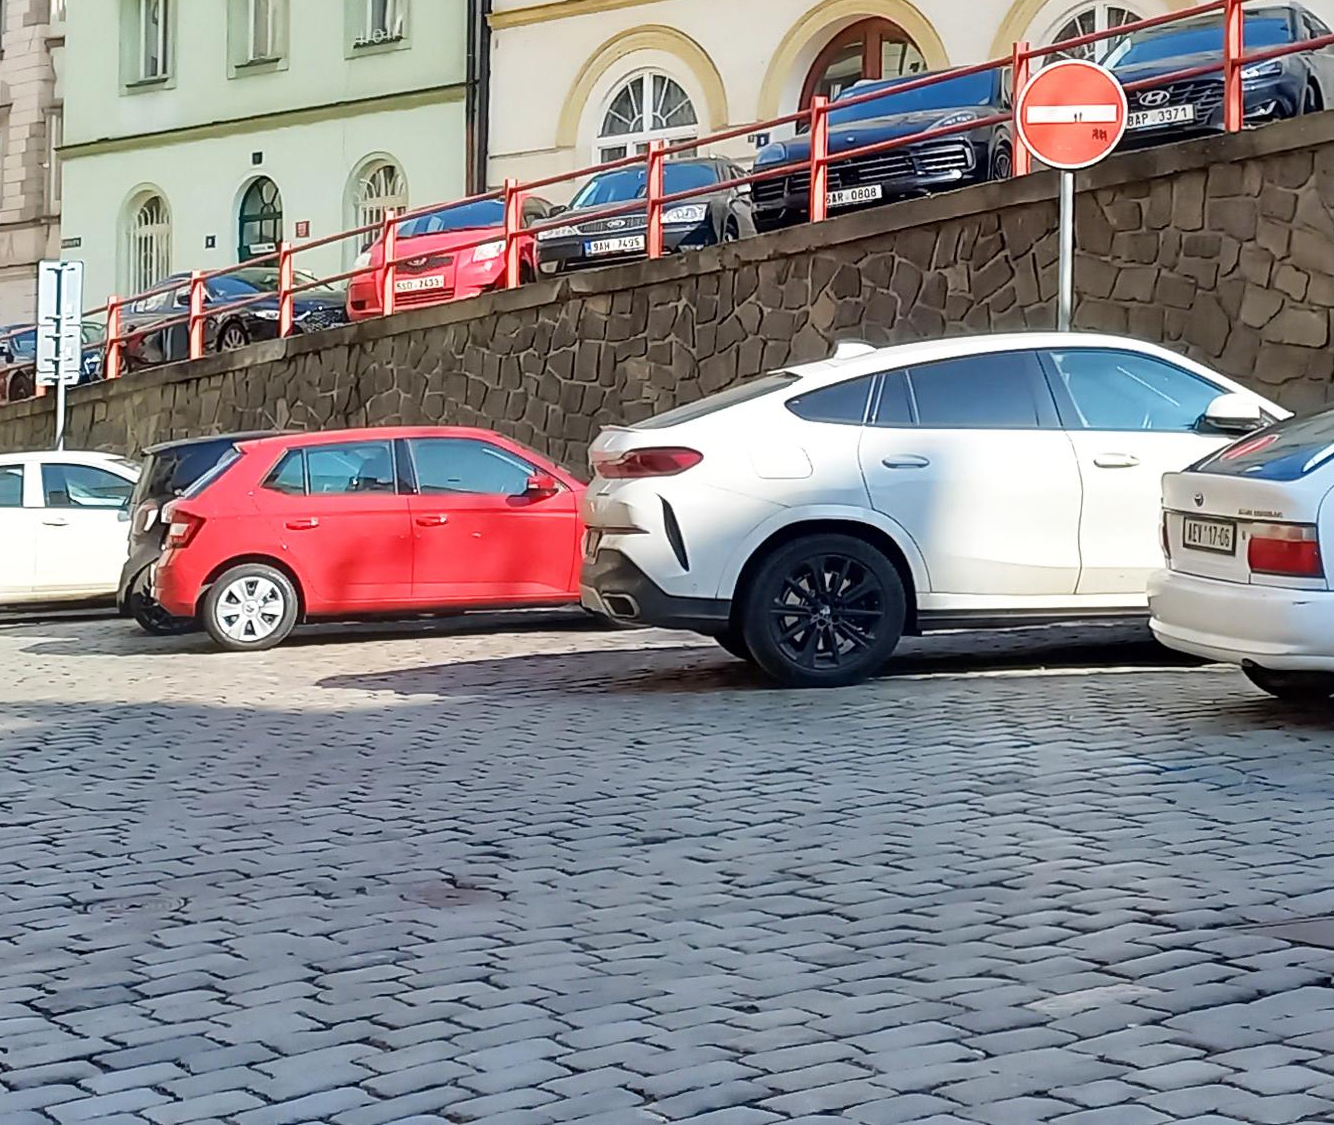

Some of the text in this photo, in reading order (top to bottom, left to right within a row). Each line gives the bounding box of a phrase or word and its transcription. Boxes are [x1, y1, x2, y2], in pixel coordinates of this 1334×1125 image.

[1158, 107, 1187, 122] 3371
[851, 187, 877, 200] 0808
[593, 241, 610, 252] 9AH
